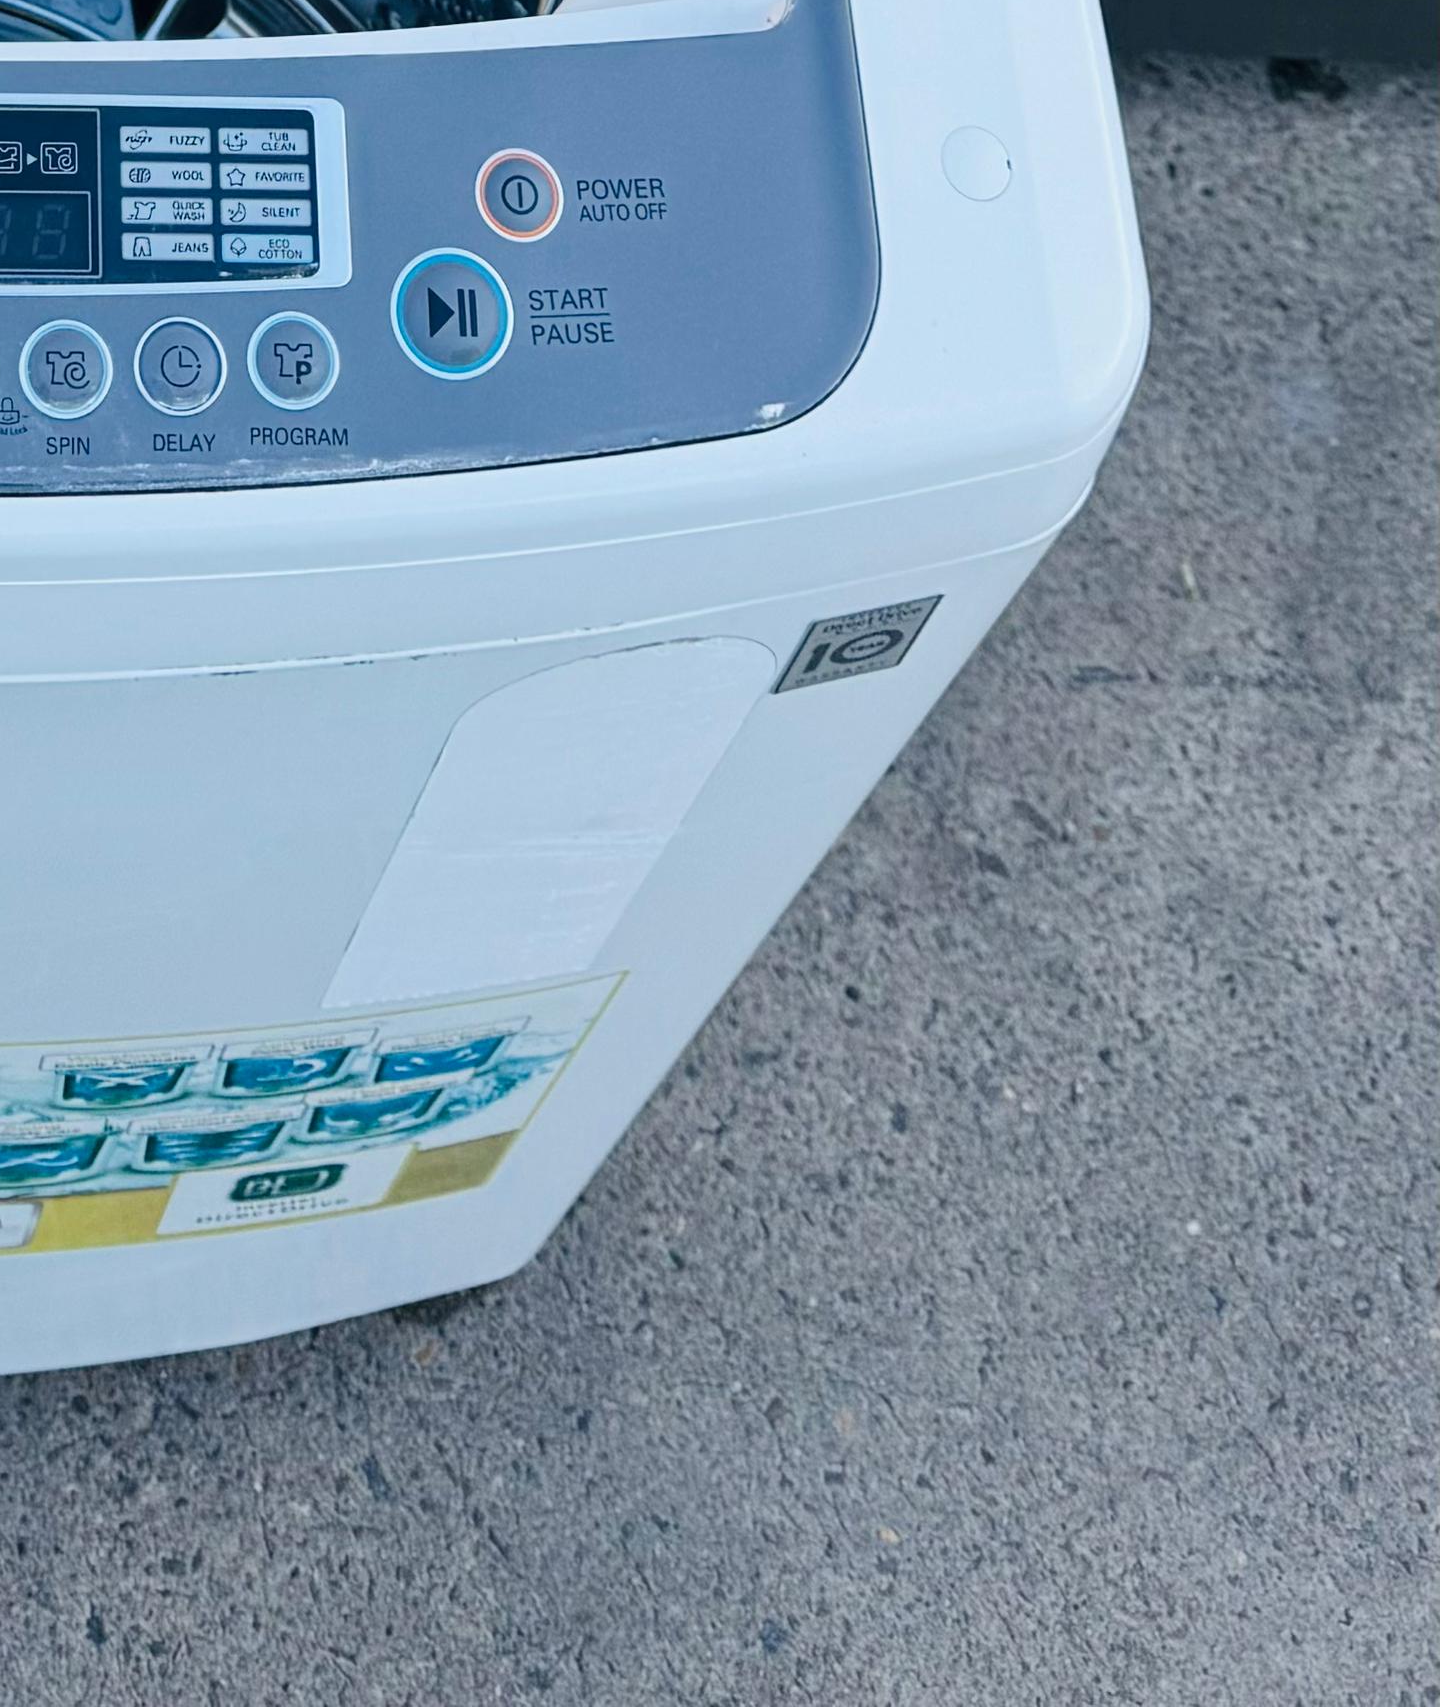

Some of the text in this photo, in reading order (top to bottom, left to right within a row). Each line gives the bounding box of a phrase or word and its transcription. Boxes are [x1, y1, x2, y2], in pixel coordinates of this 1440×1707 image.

[169, 136, 205, 145] FUZZY
[261, 143, 296, 152] CLEAN
[172, 170, 205, 181] WOOL
[255, 171, 305, 183] FAVORITE
[576, 178, 665, 201] POWER
[172, 212, 205, 221] WASH
[262, 207, 300, 218] SILENT
[578, 203, 667, 222] AUTO OFF
[171, 243, 209, 253] JEANS
[268, 239, 290, 249] ECO
[258, 248, 302, 259] COTTON
[528, 288, 608, 311] START
[531, 322, 615, 345] PAUSE
[250, 428, 349, 445] PROGRAM
[46, 438, 90, 455] SPIN
[153, 435, 216, 452] DELAY
